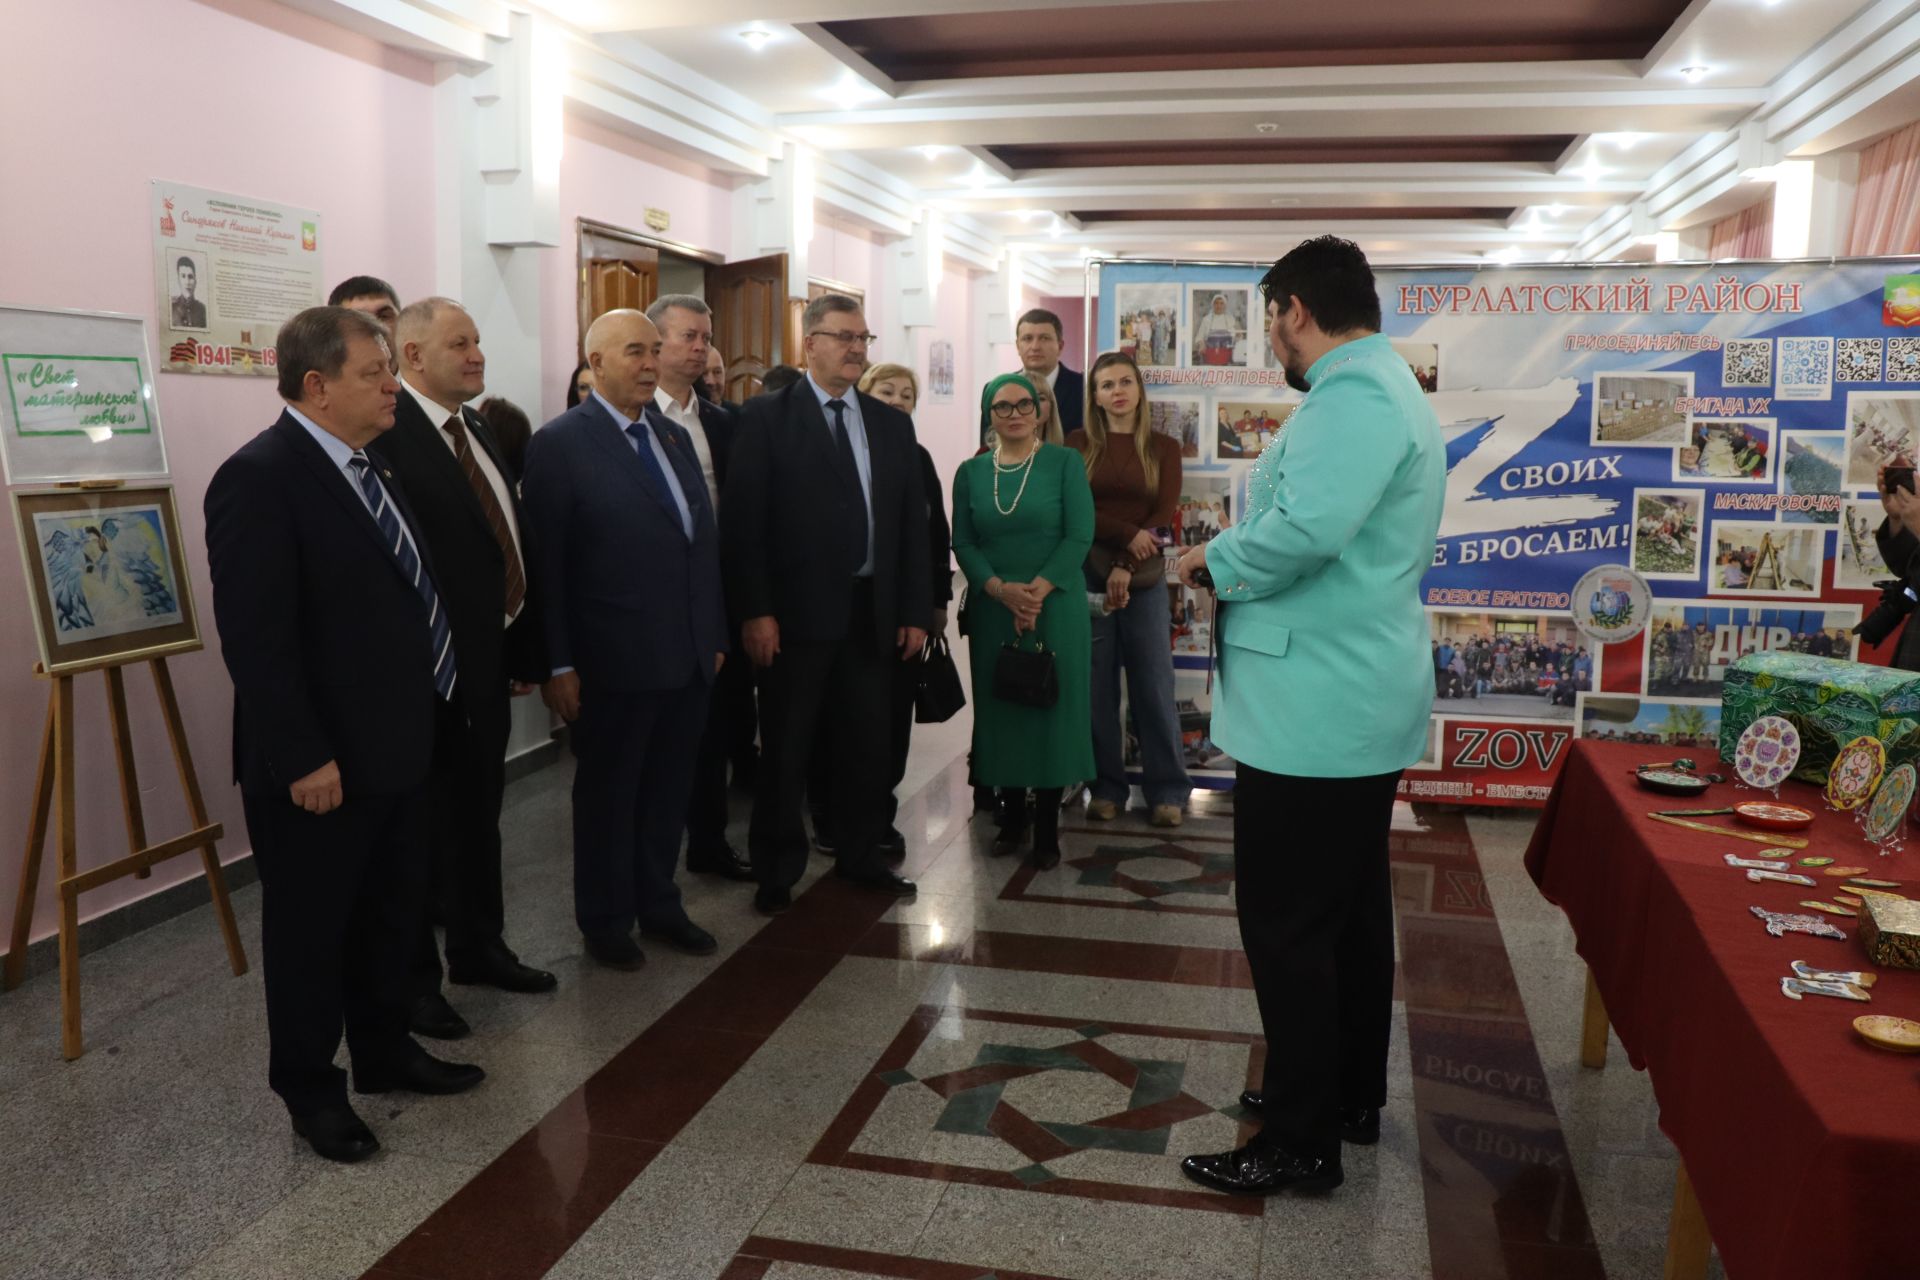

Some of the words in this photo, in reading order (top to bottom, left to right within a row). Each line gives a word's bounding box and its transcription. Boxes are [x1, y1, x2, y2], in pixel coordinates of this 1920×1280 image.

[1398, 277, 1652, 313] НУРЛАТСКИЙ
[1664, 276, 1803, 313] РАЙОН
[1564, 331, 1721, 354] ПРИСОЕДИНЯЙТЕСЬ
[195, 344, 232, 367] 1941
[261, 347, 278, 368] 19
[16, 362, 76, 388] «Свет
[1139, 367, 1202, 385] СНЯШКИ
[1202, 368, 1237, 389] ДЛЯ
[1238, 368, 1287, 389] ПОБЕД
[24, 388, 138, 413] материнской
[1674, 397, 1745, 416] БРИГАДА
[1746, 398, 1770, 415] УХ
[80, 407, 136, 425] любви»
[1500, 454, 1623, 491] СВОИХ
[1713, 493, 1842, 511] МАСКИРОВОЧКА
[1431, 544, 1448, 567] Е
[1457, 524, 1631, 565] БРОСАЕМ!
[1428, 588, 1490, 606] БОЕВОЕ
[1491, 590, 1570, 608] БРАТСТВО
[1710, 624, 1792, 665] ДНР
[1453, 728, 1568, 771] ZOV
[1410, 780, 1473, 797] ЕДИНЫ
